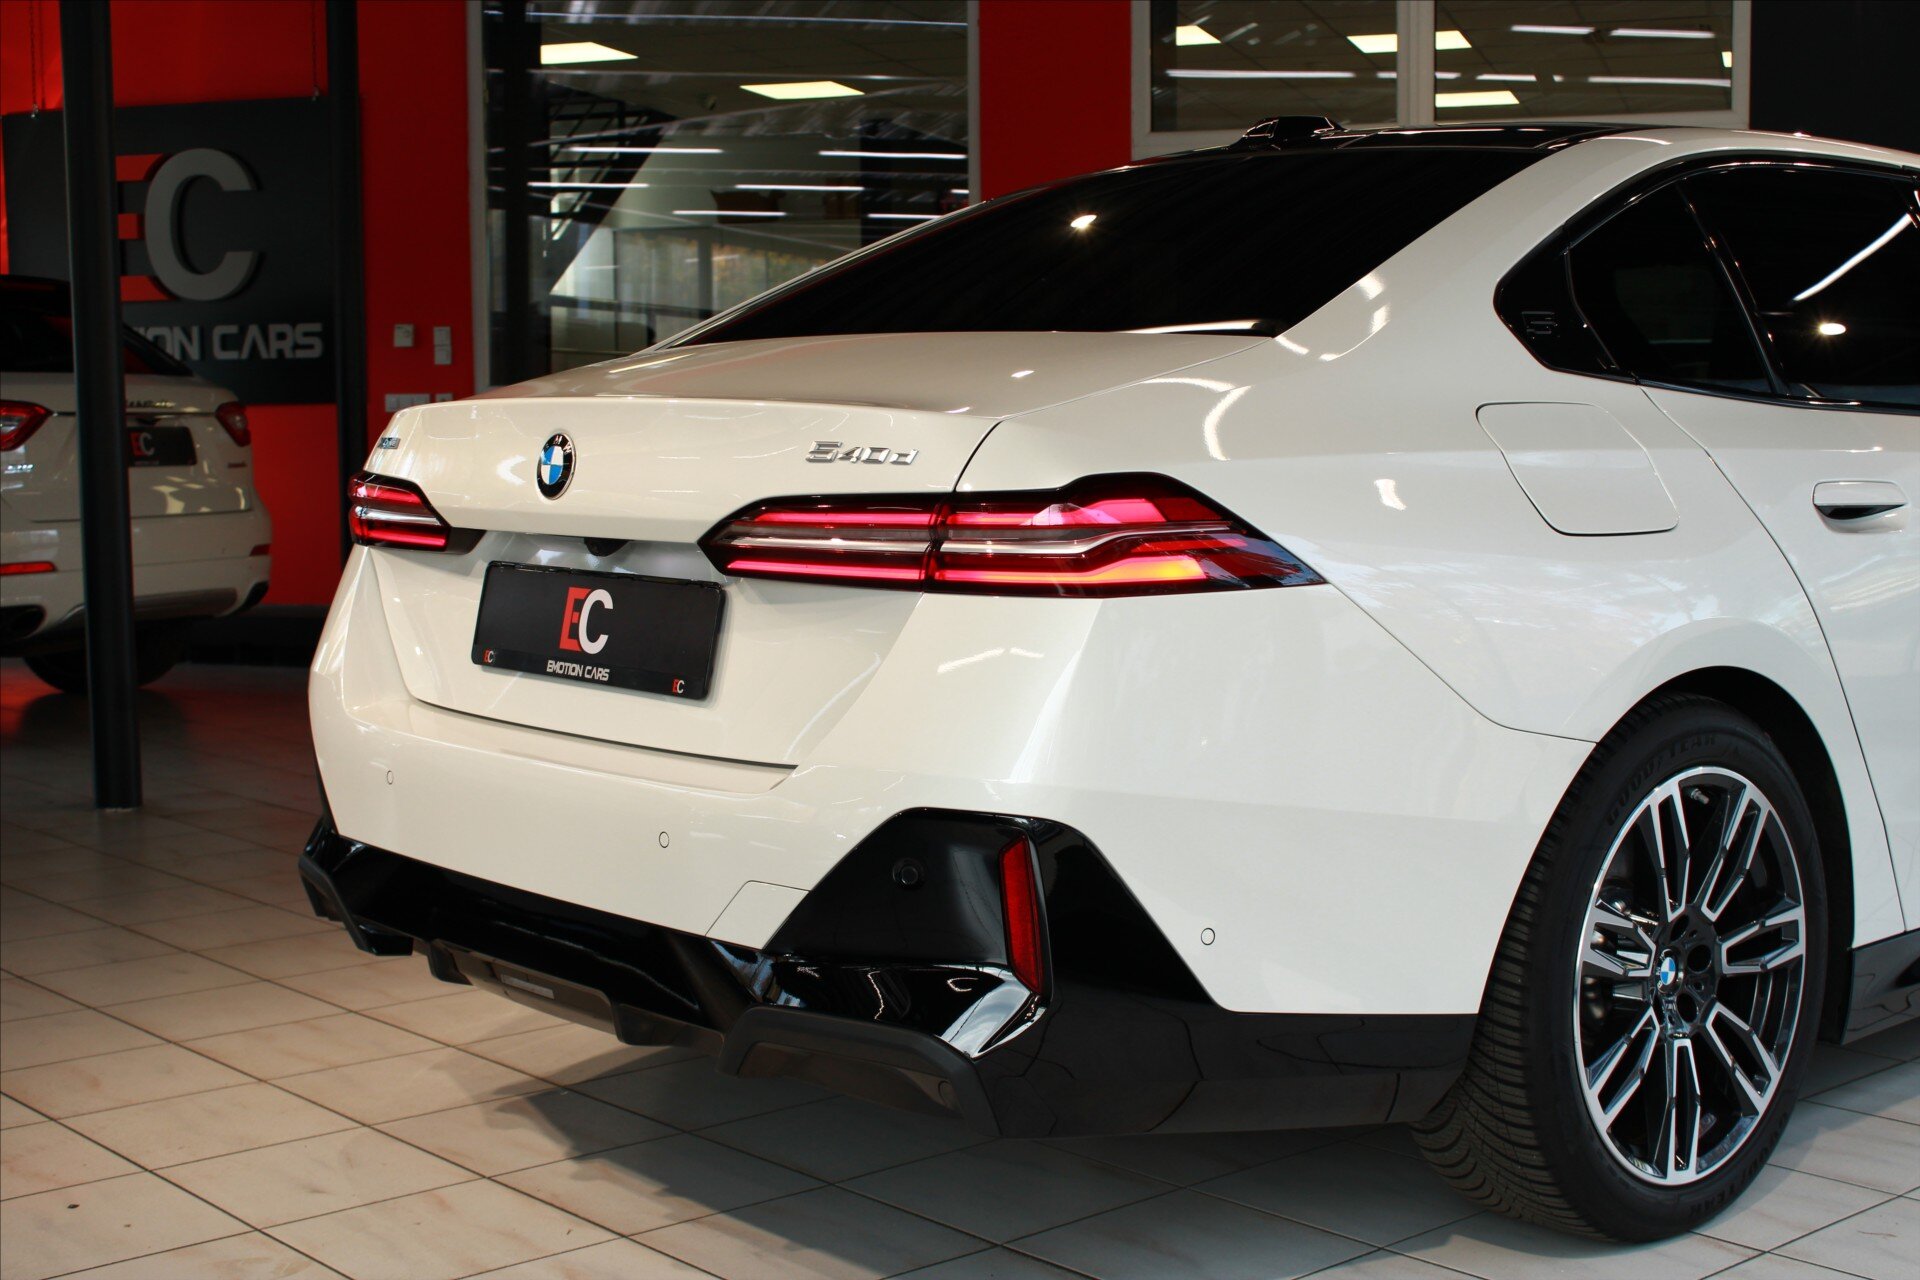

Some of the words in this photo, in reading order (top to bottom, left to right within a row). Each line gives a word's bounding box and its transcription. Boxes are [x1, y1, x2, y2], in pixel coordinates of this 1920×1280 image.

[212, 322, 324, 360] CARS
[805, 440, 920, 465] 540d
[559, 586, 614, 655] EC
[546, 659, 584, 677] EMOTION
[584, 665, 610, 682] CARS
[672, 679, 685, 694] EC
